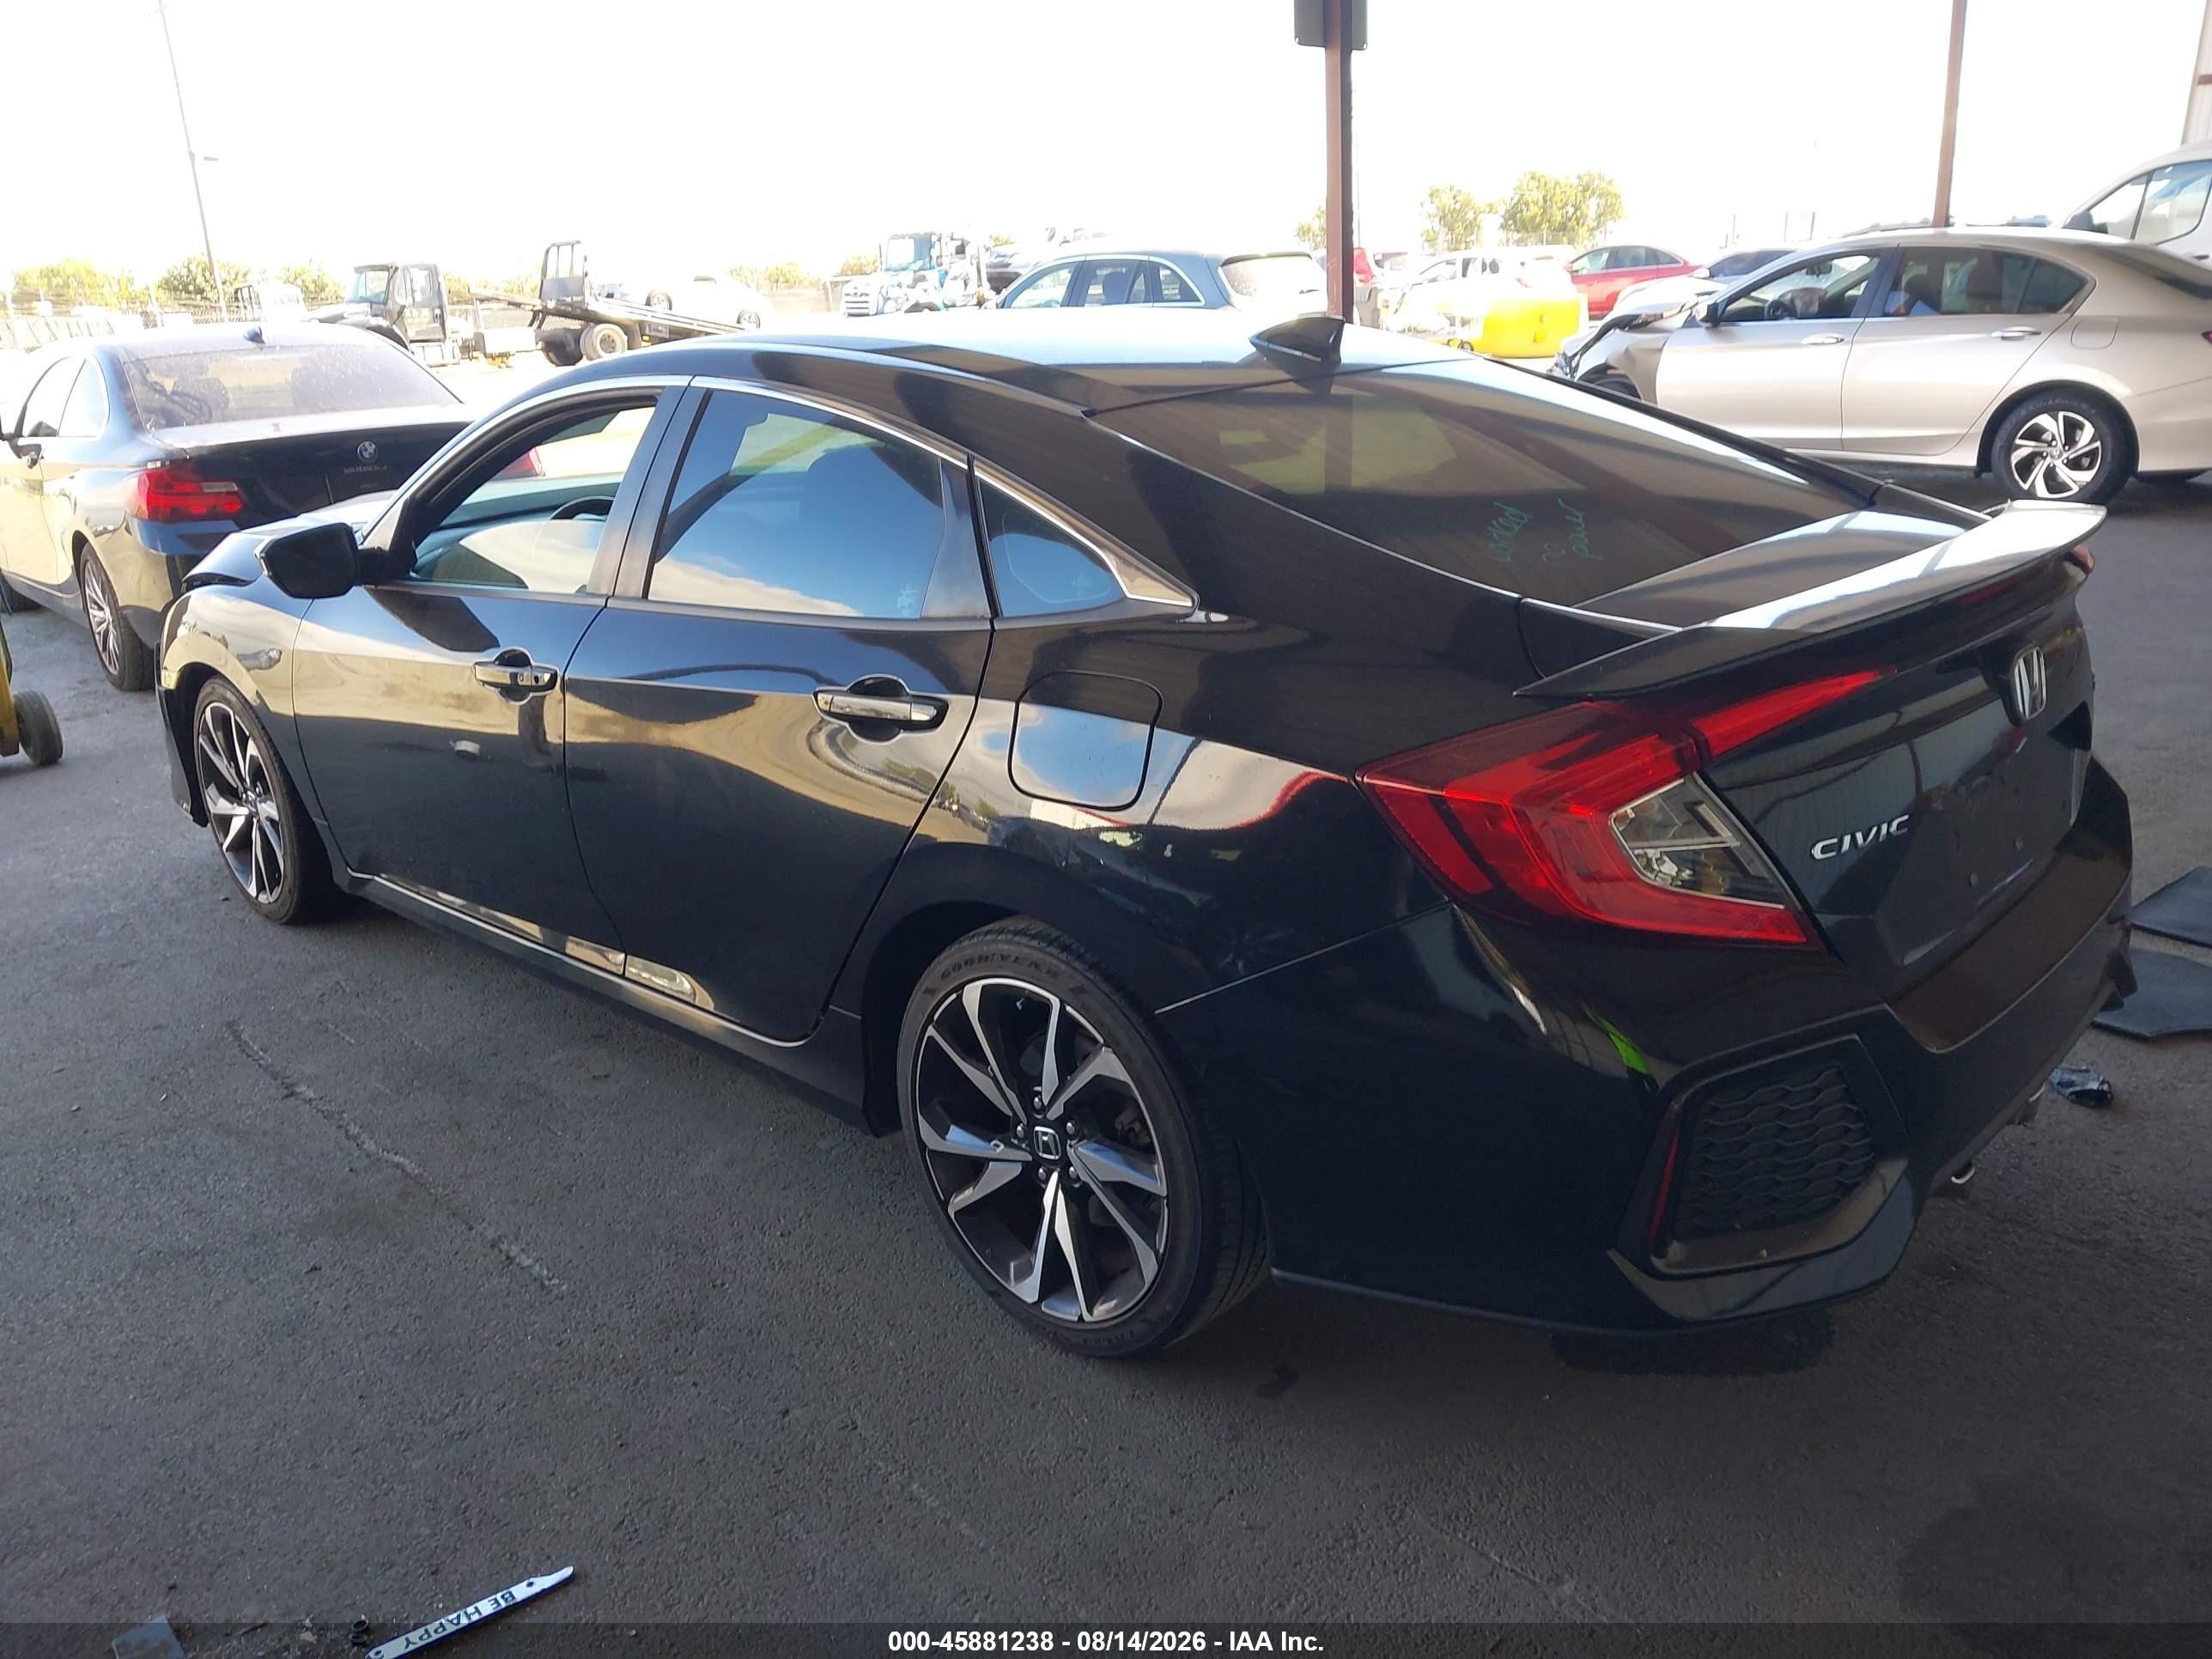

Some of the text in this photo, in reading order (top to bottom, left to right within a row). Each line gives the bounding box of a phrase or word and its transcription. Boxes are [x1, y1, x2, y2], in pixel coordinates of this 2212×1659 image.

[1811, 814, 1909, 860] CIVIC
[403, 1590, 516, 1650] BE HAPPY
